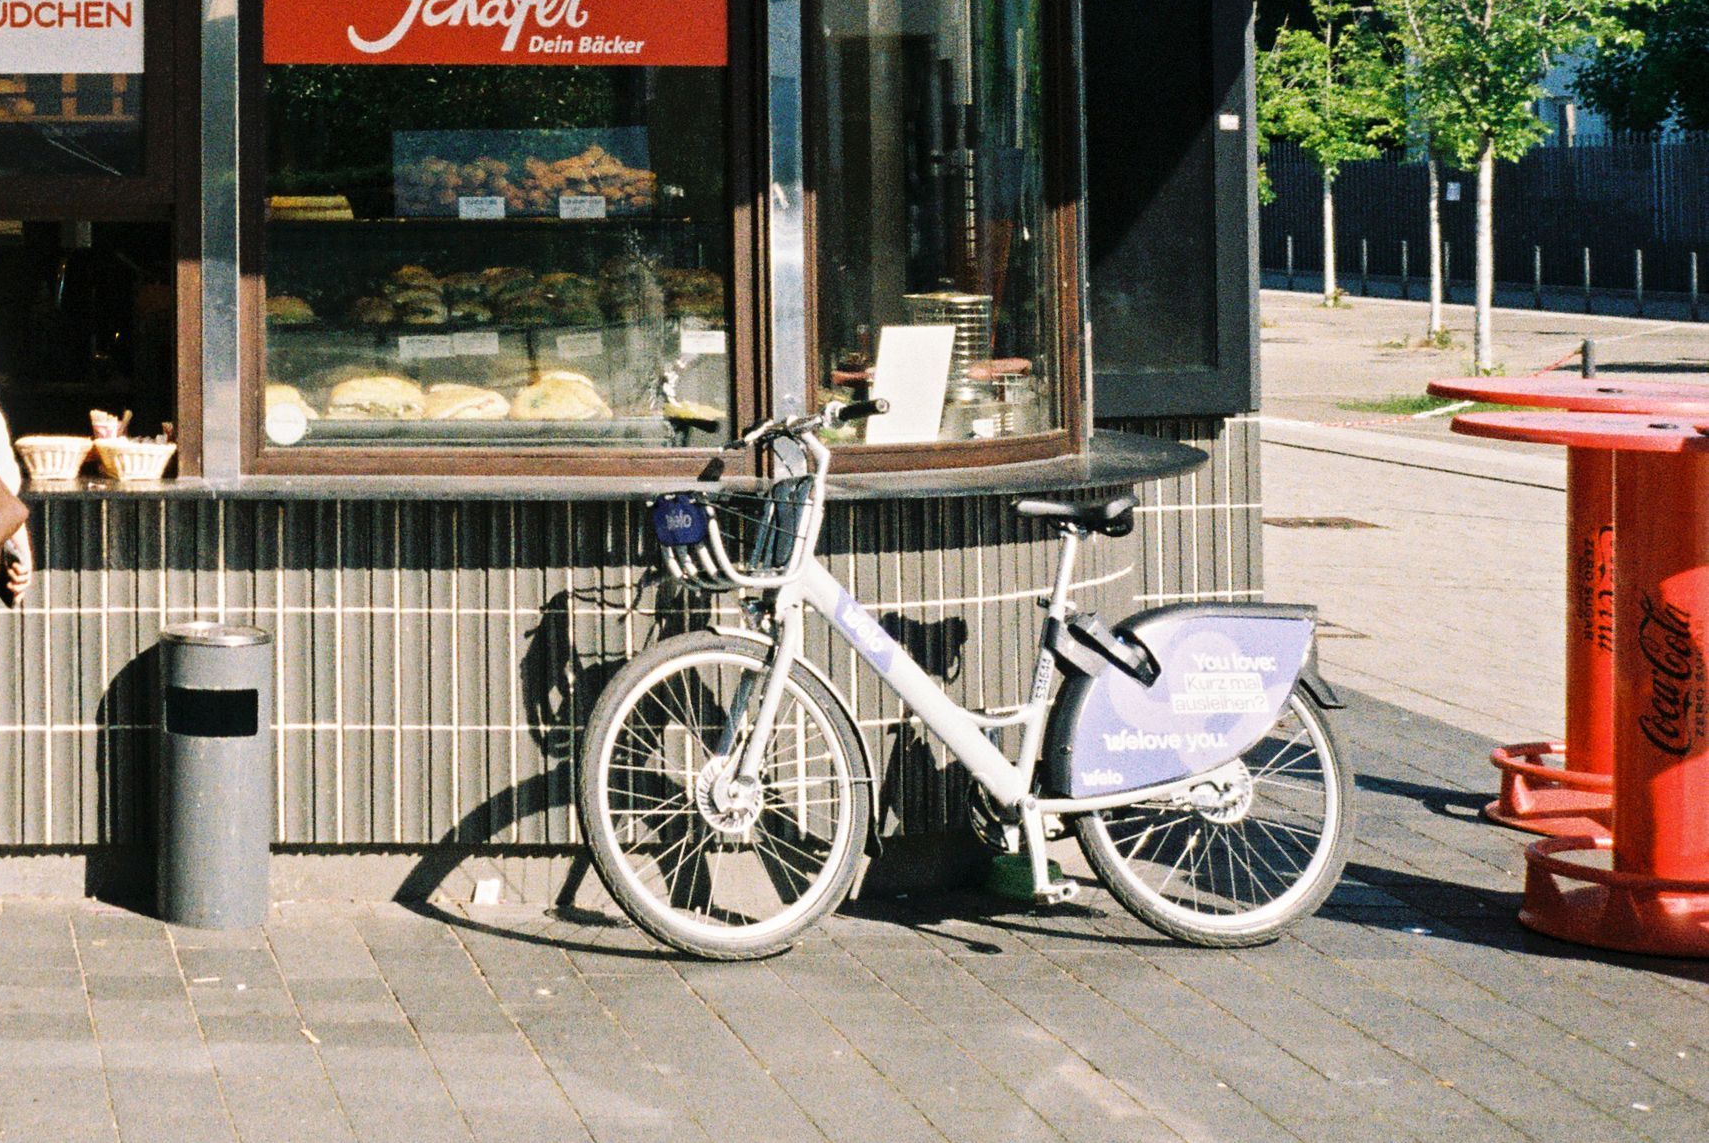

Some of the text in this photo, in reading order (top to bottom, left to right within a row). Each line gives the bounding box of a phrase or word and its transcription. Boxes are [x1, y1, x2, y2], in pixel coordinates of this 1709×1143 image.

[529, 35, 645, 54] Dein Bäcker
[1193, 653, 1230, 672] You
[1187, 674, 1261, 690] Kurz mal
[1174, 694, 1266, 712] ausleihen?
[1694, 689, 1706, 737] ZERO
[1184, 731, 1228, 753] you.
